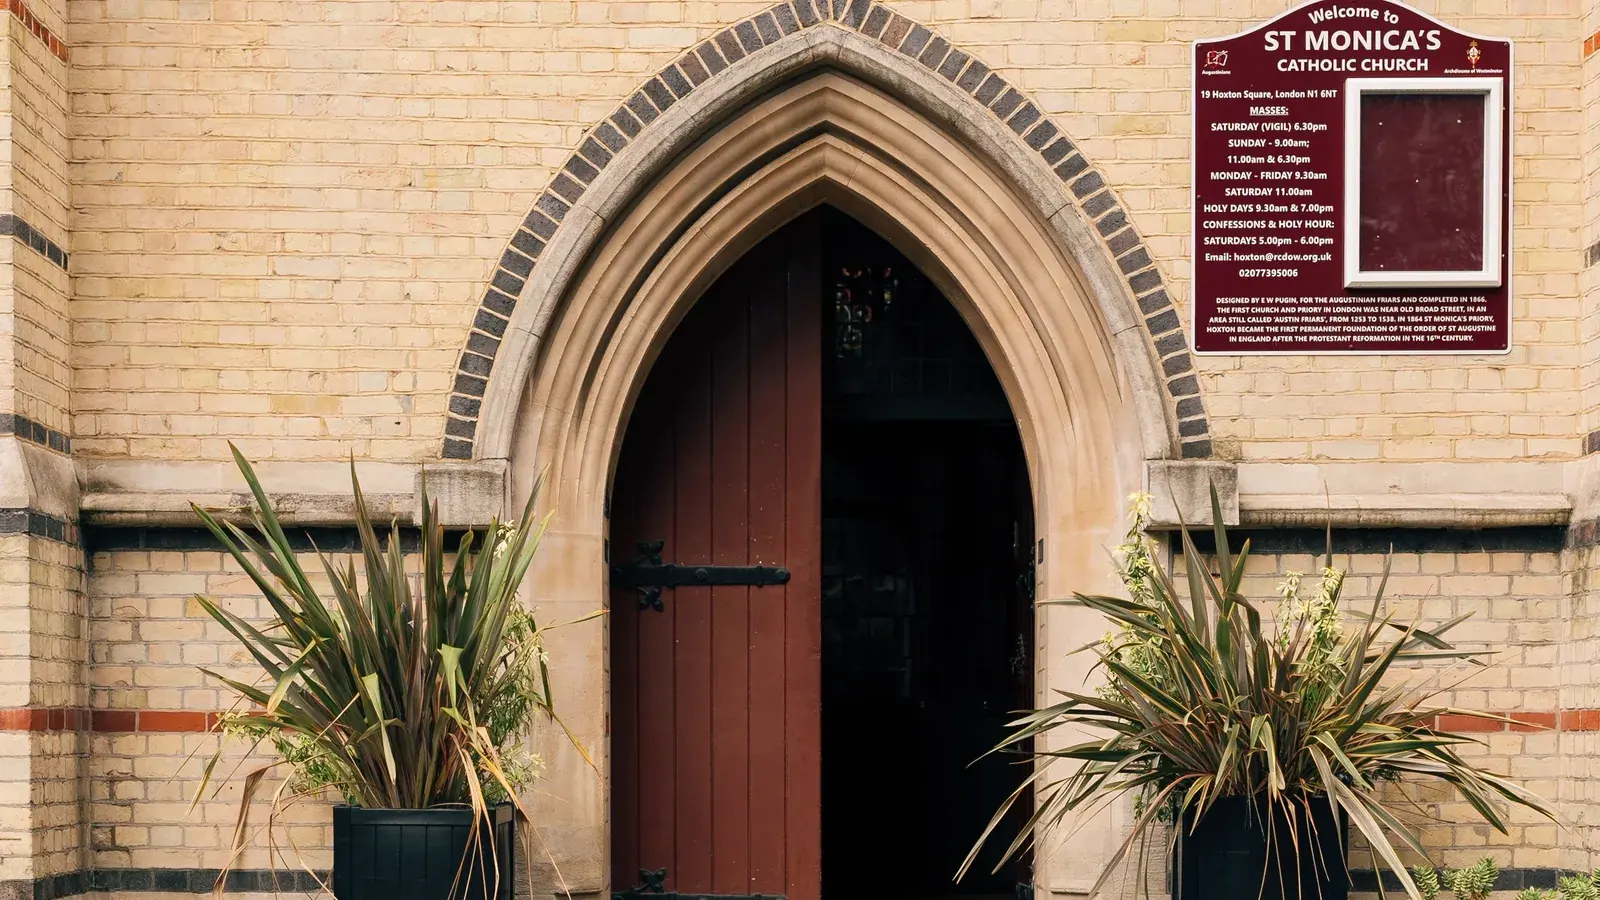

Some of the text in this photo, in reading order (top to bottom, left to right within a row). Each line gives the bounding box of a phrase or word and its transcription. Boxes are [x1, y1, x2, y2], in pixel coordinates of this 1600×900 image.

[1308, 5, 1399, 24] Welcome to
[1264, 31, 1296, 51] ST
[1277, 59, 1428, 71] CATHOLIC CHURCH
[1201, 89, 1337, 100] 19 Hoxton Square, London N1 6NT
[1250, 106, 1288, 116] MASSES:
[1211, 122, 1327, 132] SATURDAY (VIGIL) 6.30pm
[1228, 139, 1266, 147] SUNDAY
[1275, 139, 1310, 148] 9.00am;
[1228, 155, 1310, 165] 11.00am & 6.30pm
[1210, 172, 1252, 180] MONDAY
[1261, 171, 1293, 179] FRIDAY
[1295, 171, 1327, 179] 9.30am
[1225, 188, 1312, 196] SATURDAY 11.00am
[1204, 204, 1333, 214] HOLY DAYS 9.30am & 7.00pm
[1203, 220, 1334, 228] CONFESSIONS & HOLY HOUR:
[1204, 237, 1256, 245] SATURDAYS
[1259, 237, 1291, 246] 5.00pm
[1300, 236, 1333, 246] 6.00pm
[1205, 252, 1332, 263] Email: hoxton@rcdow.org.uk
[1239, 269, 1298, 277] 02077395006
